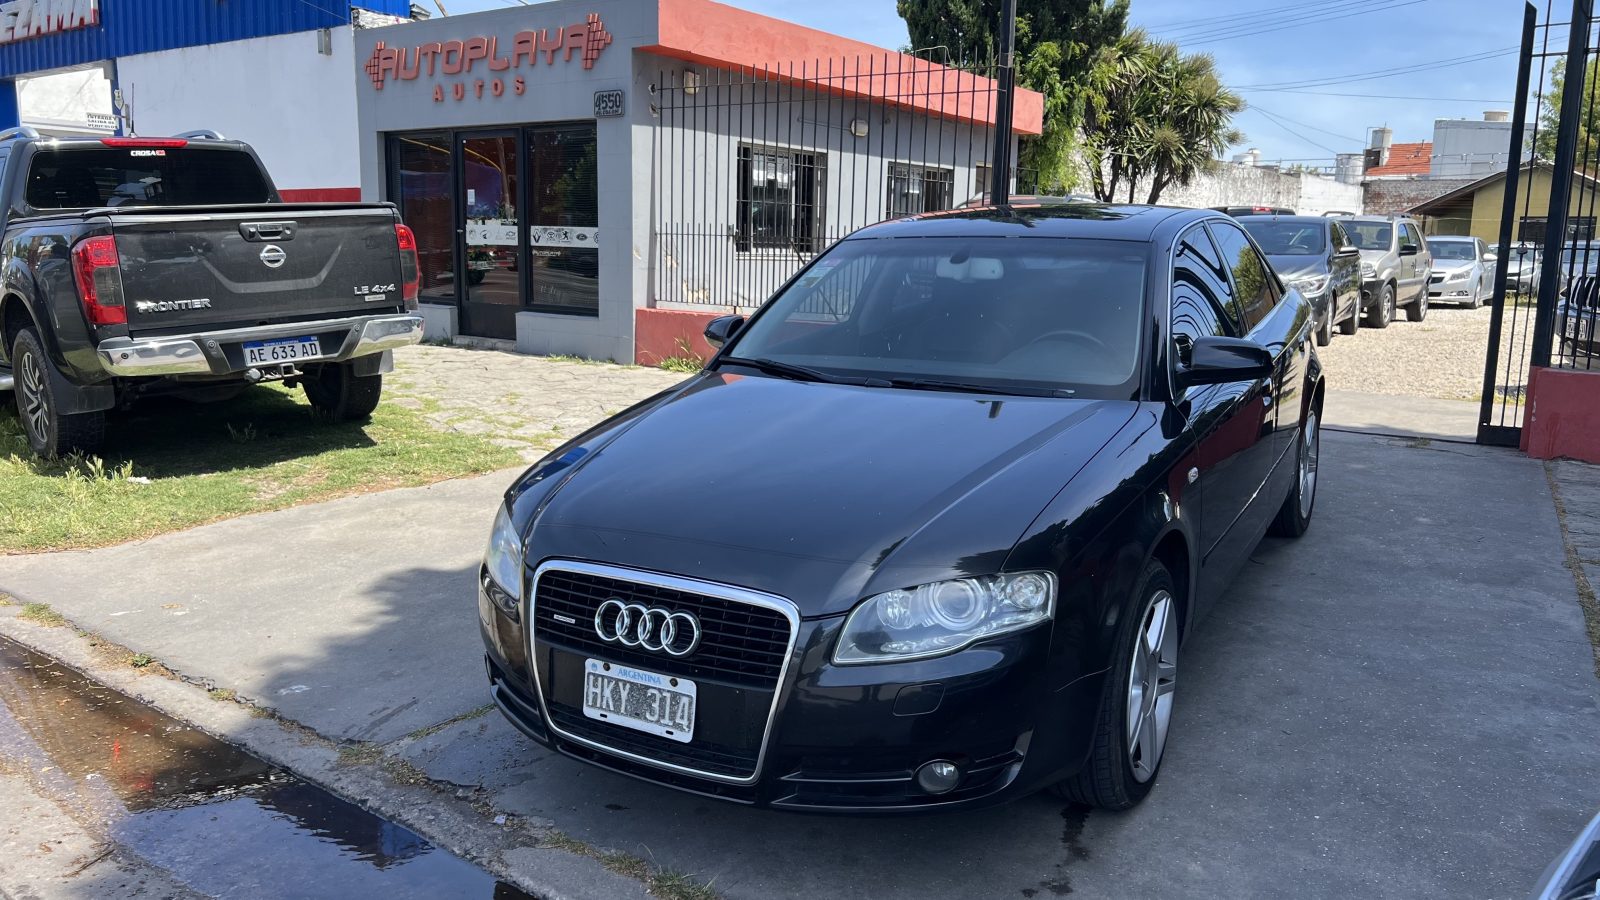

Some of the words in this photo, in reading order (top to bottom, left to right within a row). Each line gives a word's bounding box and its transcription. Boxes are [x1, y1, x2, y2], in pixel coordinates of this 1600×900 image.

[378, 24, 592, 80] AUTOPLAYA
[433, 76, 525, 102] AUTOS
[595, 92, 621, 110] 4550
[354, 285, 369, 295] LE
[136, 298, 212, 313] FRONTIER
[249, 348, 267, 363] AE
[271, 345, 297, 360] 633
[302, 342, 318, 357] AD
[618, 668, 662, 685] ARGENTINA
[588, 674, 631, 714] HKY
[645, 688, 691, 732] 314
